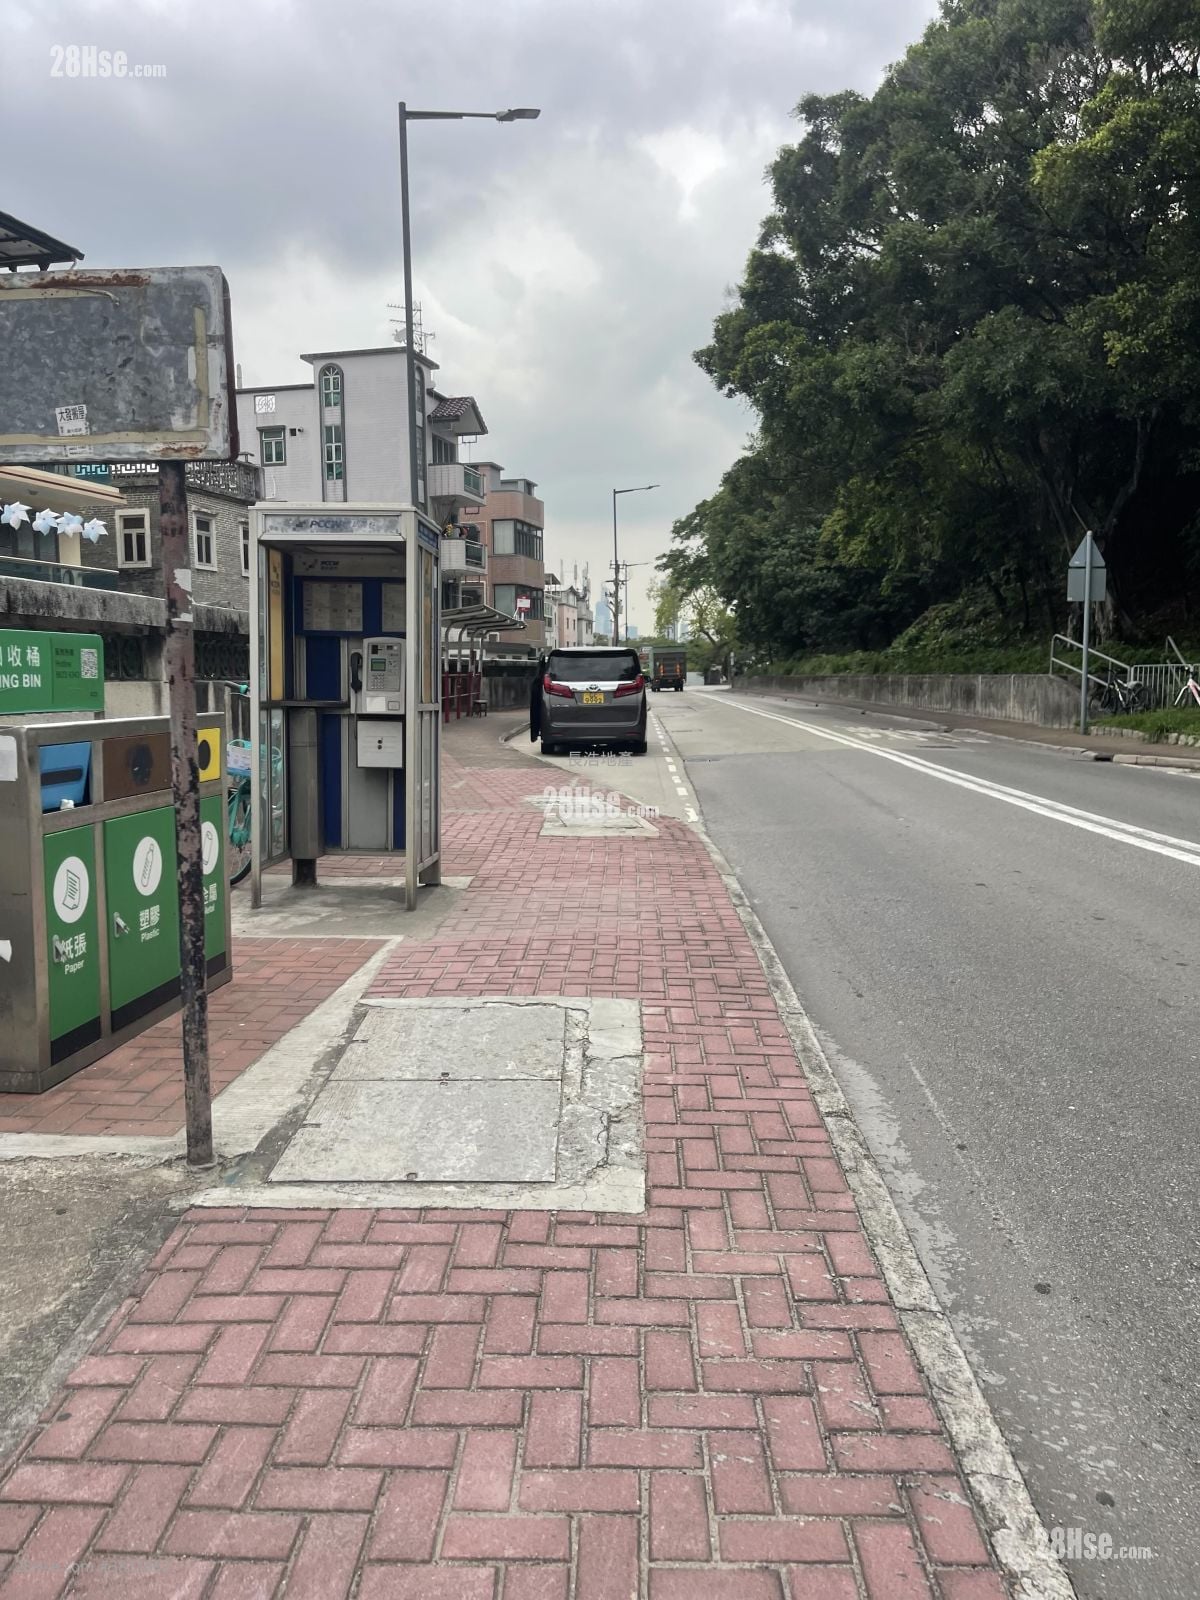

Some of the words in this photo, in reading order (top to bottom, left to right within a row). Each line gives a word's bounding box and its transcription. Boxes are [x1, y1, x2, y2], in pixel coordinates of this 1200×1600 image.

[22, 673, 42, 688] BIN
[139, 905, 161, 931] 塑膠
[140, 927, 160, 943] Plastic
[64, 960, 85, 975] Paper
